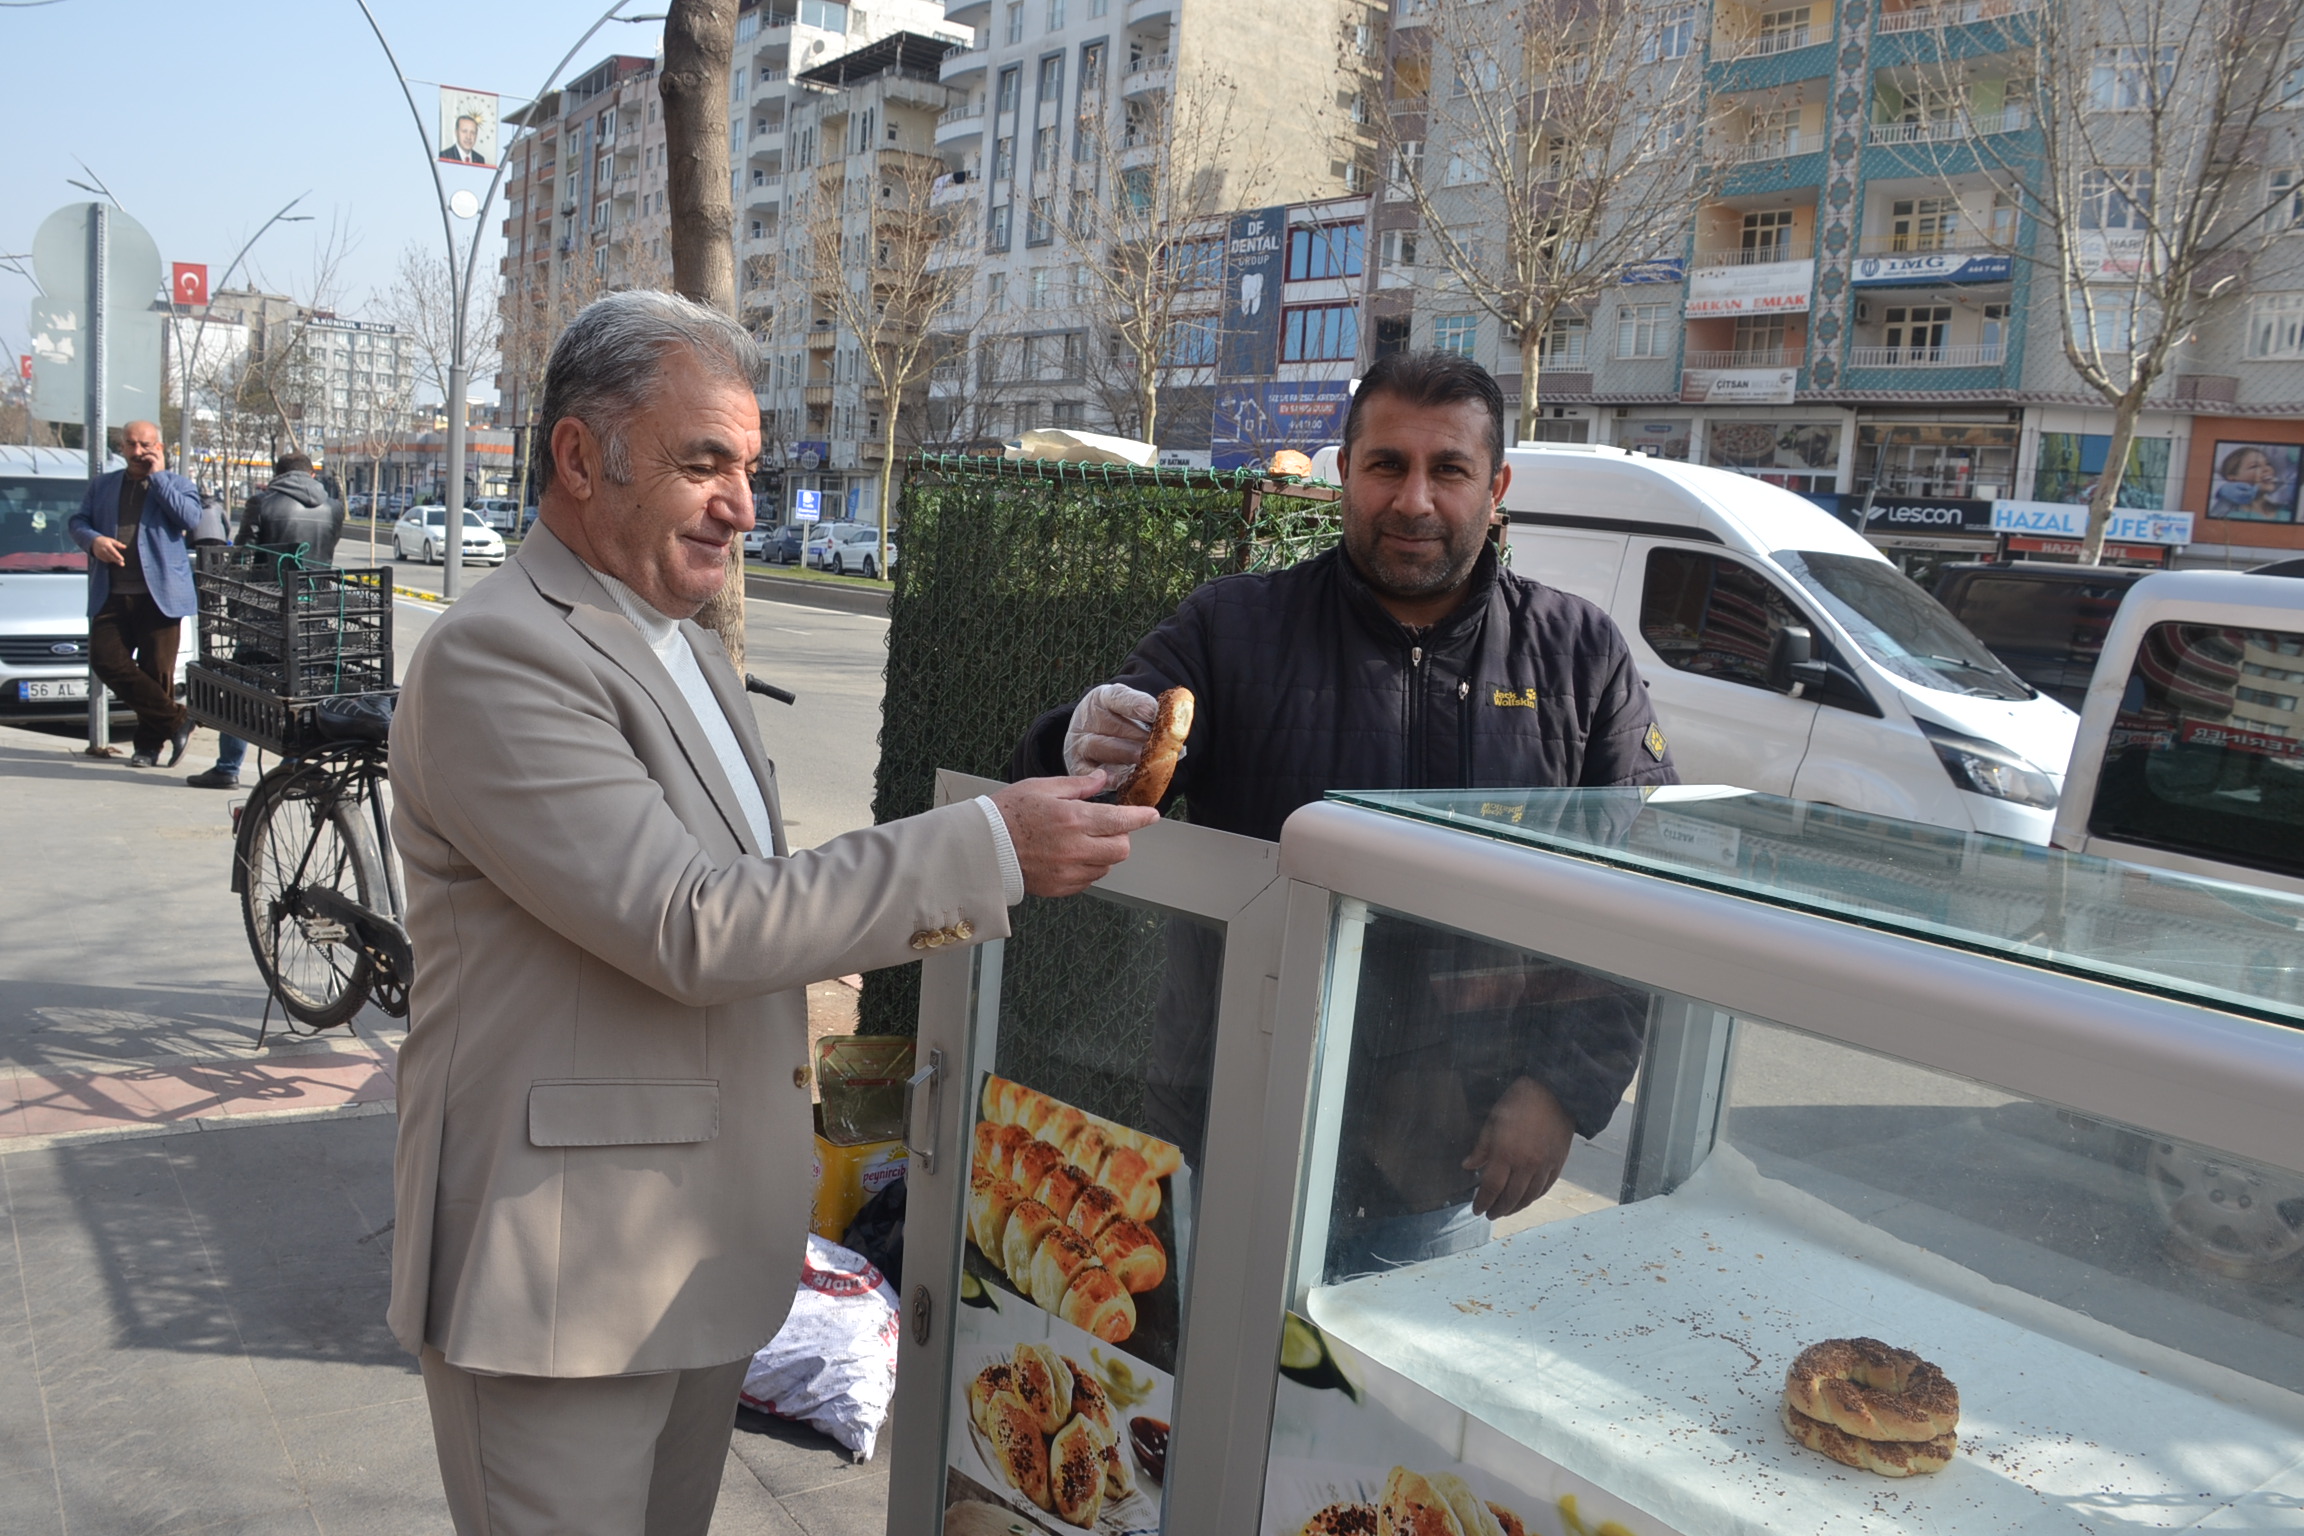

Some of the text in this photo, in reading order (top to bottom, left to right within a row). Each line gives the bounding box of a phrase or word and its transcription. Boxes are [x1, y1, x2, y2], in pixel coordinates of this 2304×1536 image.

[1248, 221, 1264, 236] DF
[1231, 236, 1280, 253] DENTAL
[1239, 255, 1270, 266] GROUP
[1688, 299, 1742, 312] MEKAN
[1753, 294, 1807, 308] EMLAK
[1716, 379, 1749, 391] ÇİTSAN
[1996, 510, 2148, 538] HAZAL ÜFE
[30, 684, 49, 697] 56
[58, 683, 76, 696] AL
[1494, 690, 1517, 699] Jack
[1494, 698, 1535, 709] Wolfskin
